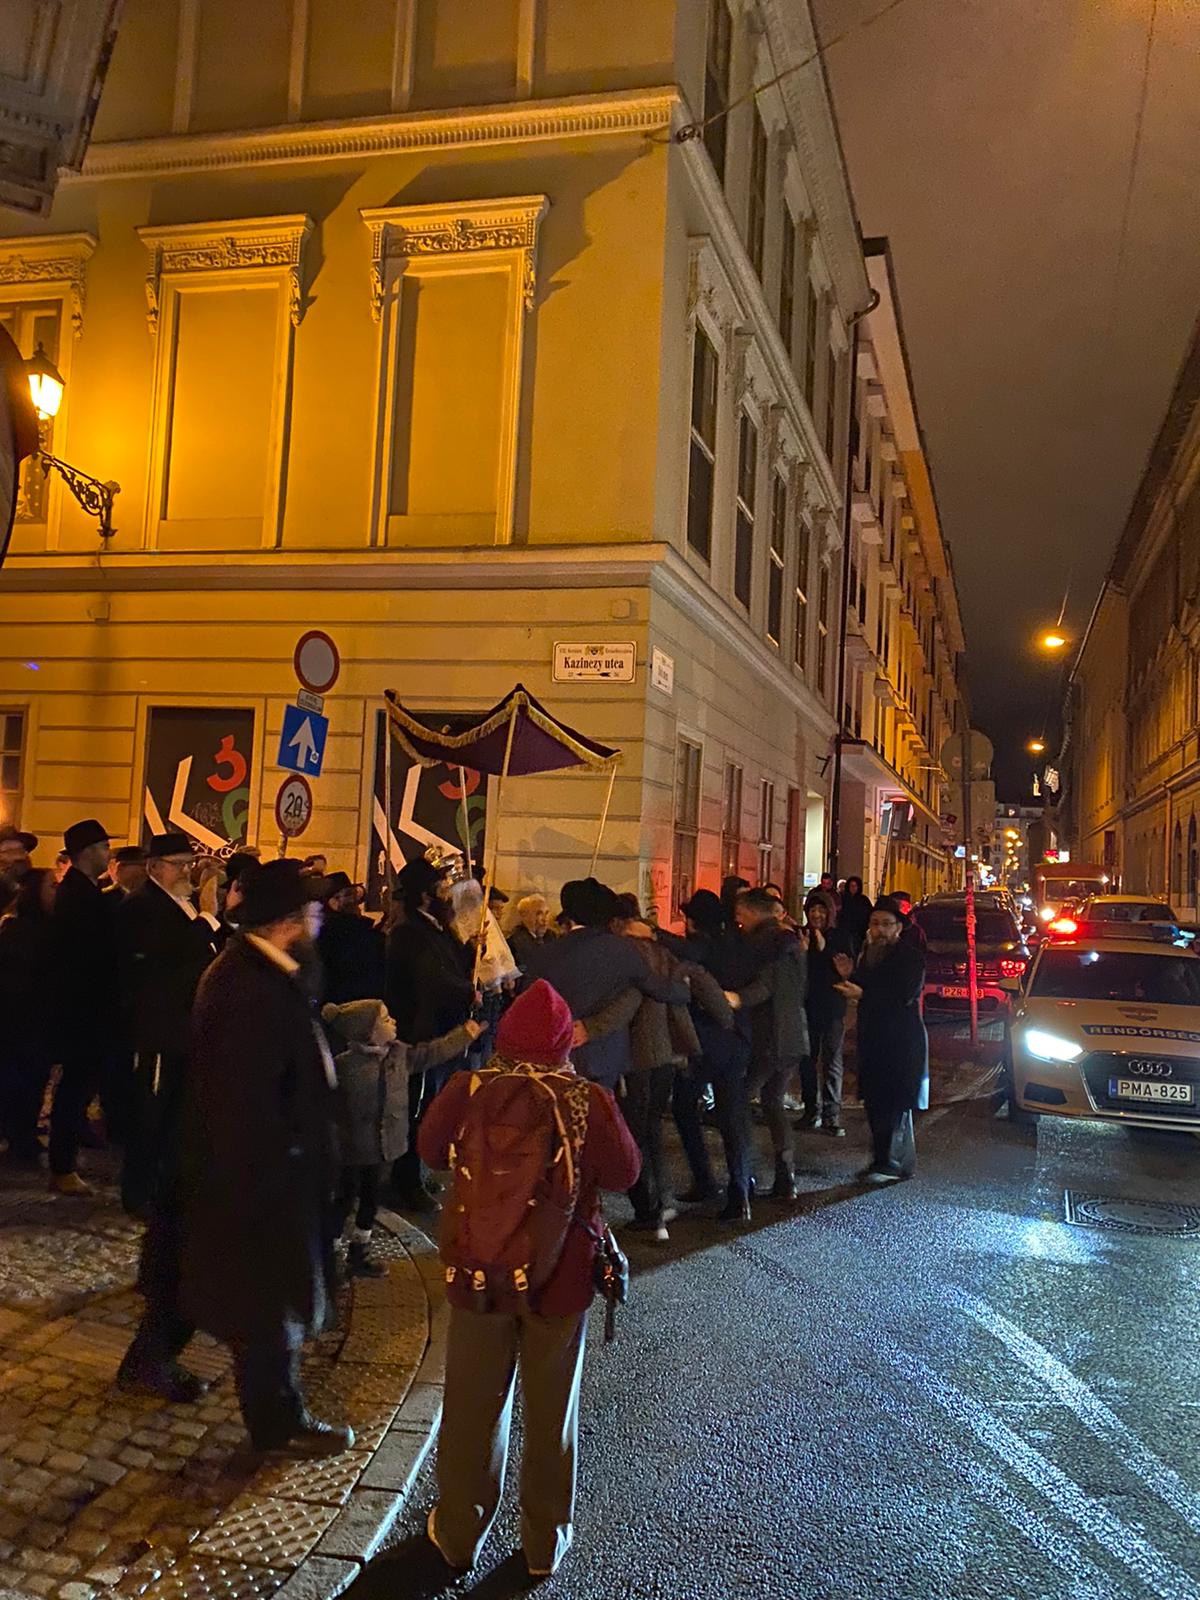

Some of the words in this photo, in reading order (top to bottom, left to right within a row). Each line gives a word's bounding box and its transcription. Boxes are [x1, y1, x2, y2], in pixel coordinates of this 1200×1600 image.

[564, 656, 602, 672] Kazinczy
[605, 657, 624, 669] utca
[1120, 1081, 1188, 1100] PMA-825
